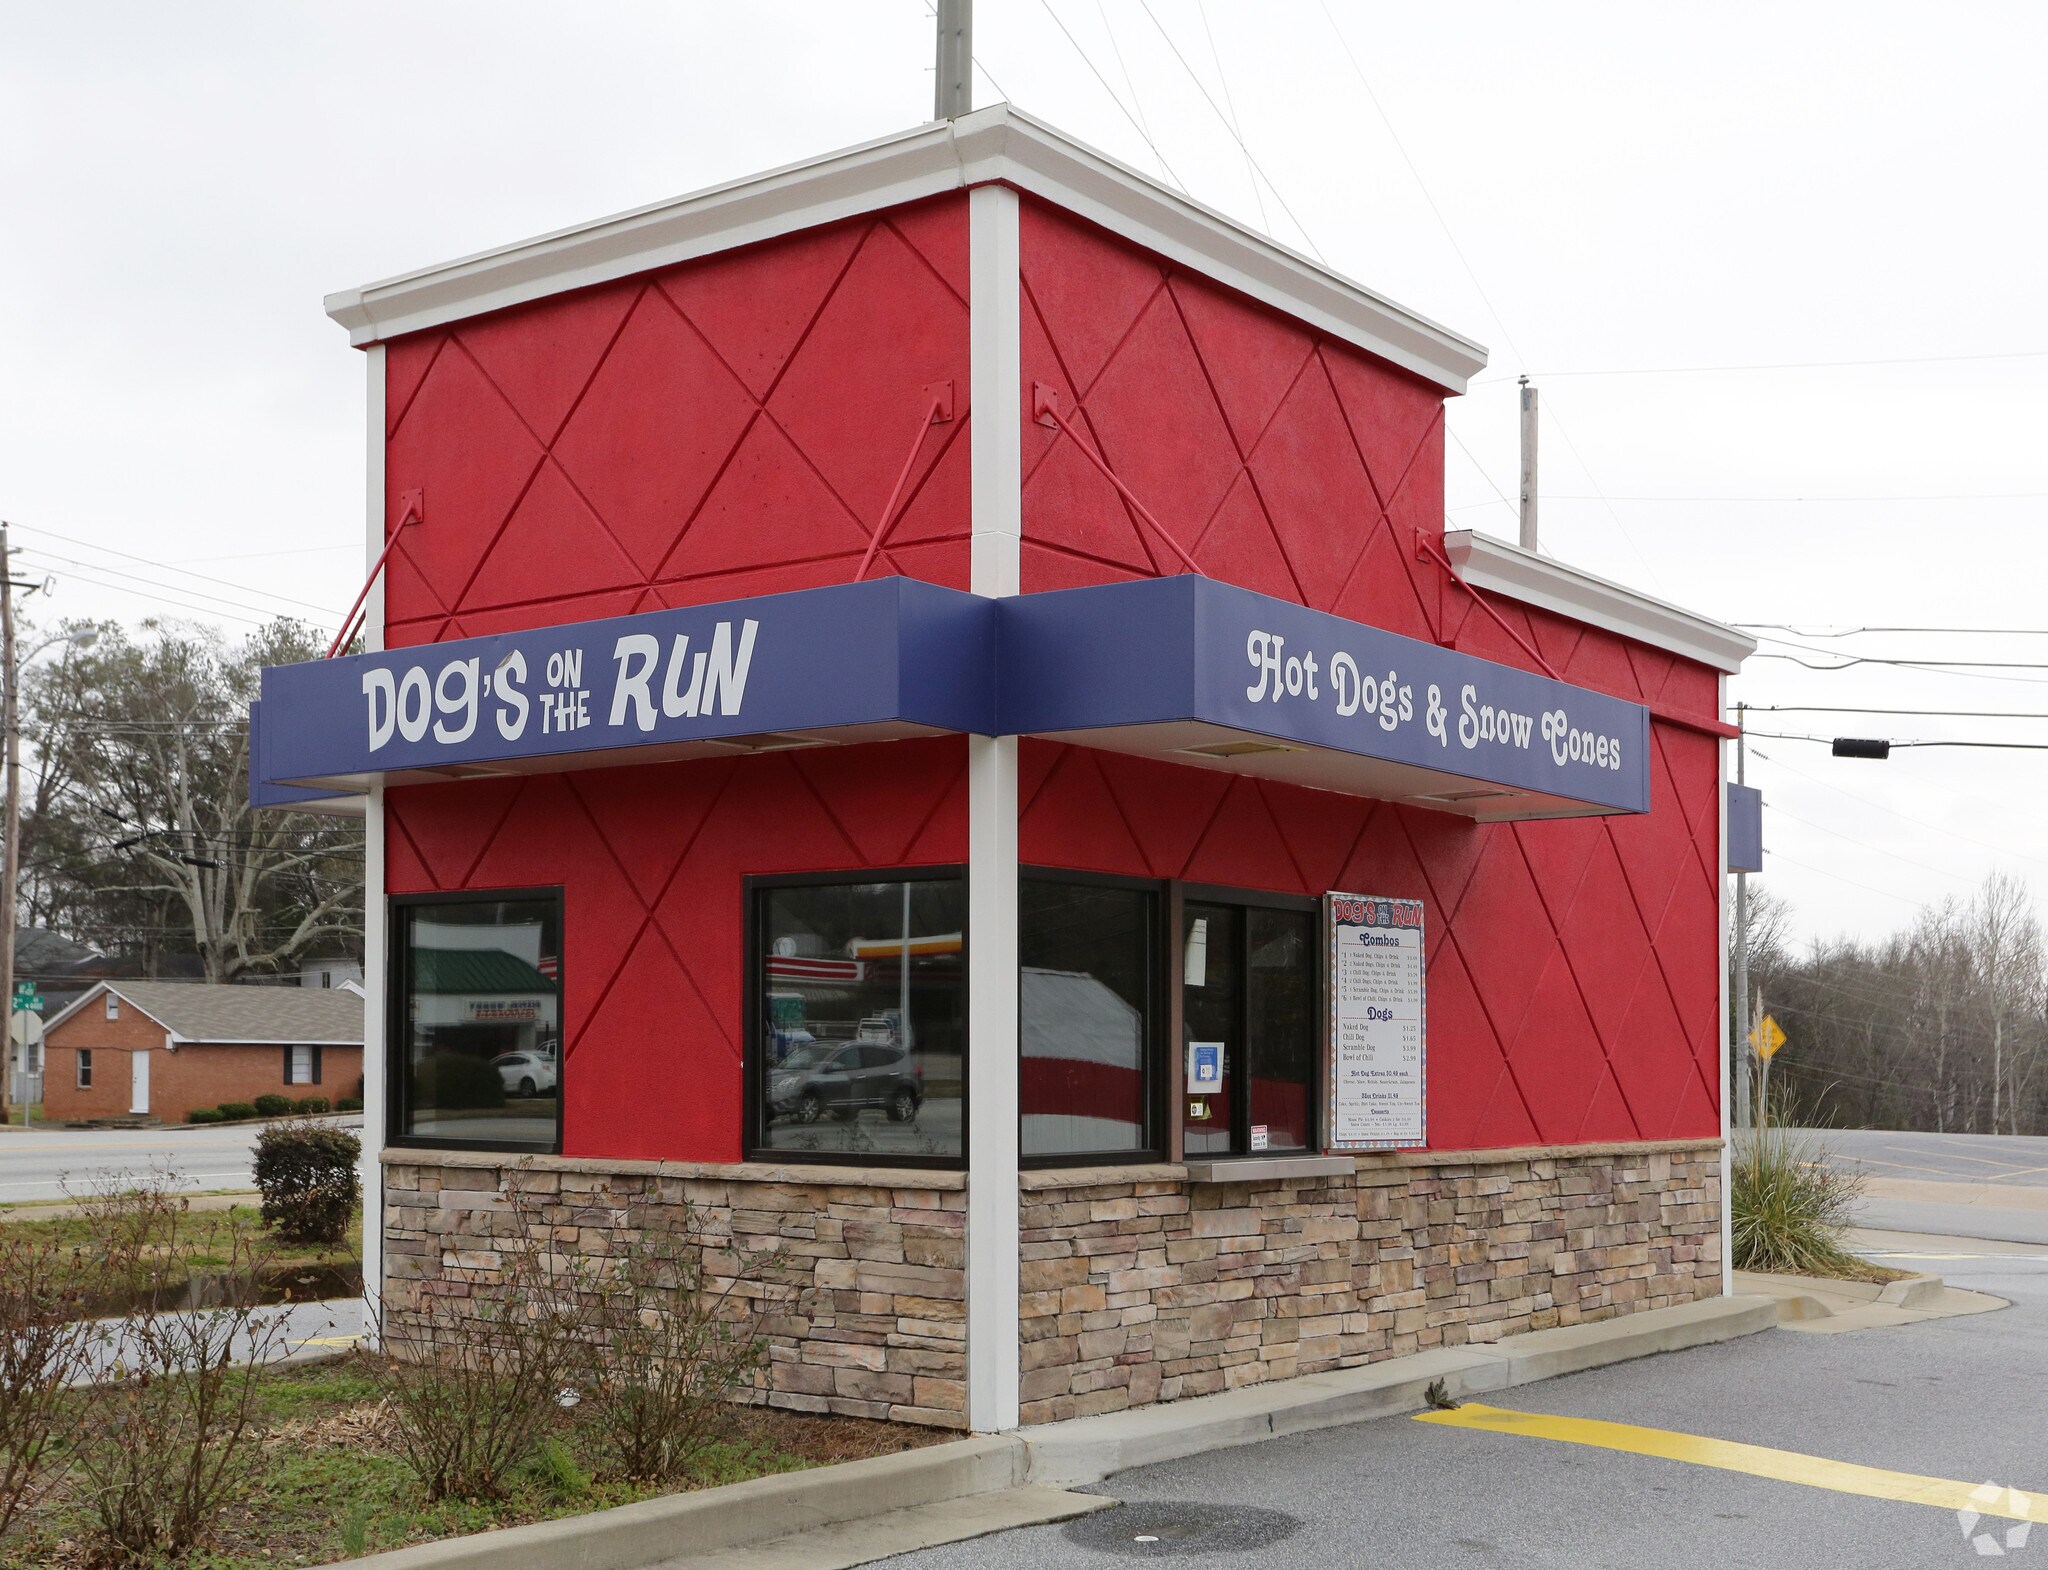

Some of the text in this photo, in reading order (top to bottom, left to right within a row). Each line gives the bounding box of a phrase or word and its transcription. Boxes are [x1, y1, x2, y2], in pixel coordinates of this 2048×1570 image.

[546, 648, 583, 690] ON
[1246, 629, 1621, 771] Hot Dogs & Snow Cones
[539, 690, 591, 734] THE
[1378, 905, 1388, 914] ON
[1378, 914, 1389, 924] THE
[1360, 932, 1400, 946] Combos
[1367, 1006, 1393, 1021] Dogs
